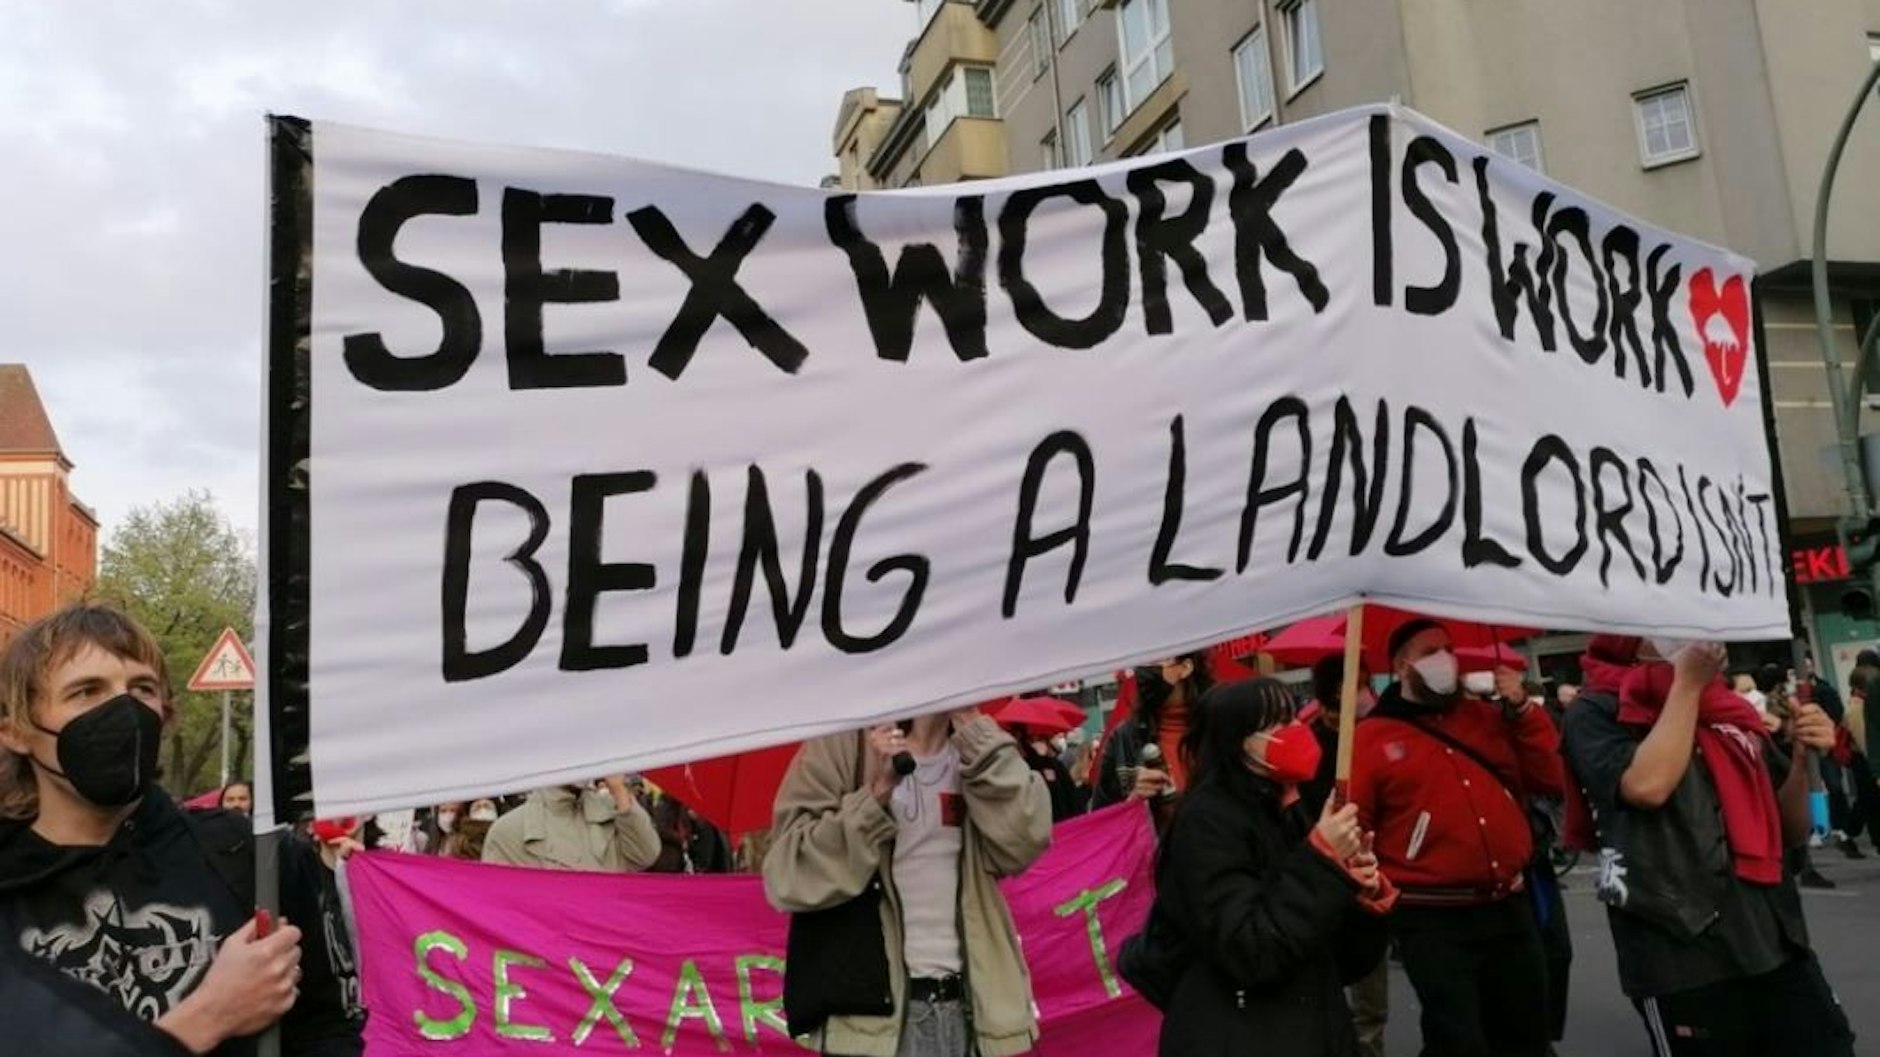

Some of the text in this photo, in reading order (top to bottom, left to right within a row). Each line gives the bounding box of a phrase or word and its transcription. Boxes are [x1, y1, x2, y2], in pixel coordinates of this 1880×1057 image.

[344, 113, 1695, 399] SEX WORK IS WORK
[441, 462, 931, 683] BEING
[1002, 429, 1095, 619] A
[1148, 395, 1684, 588] LANDLORD
